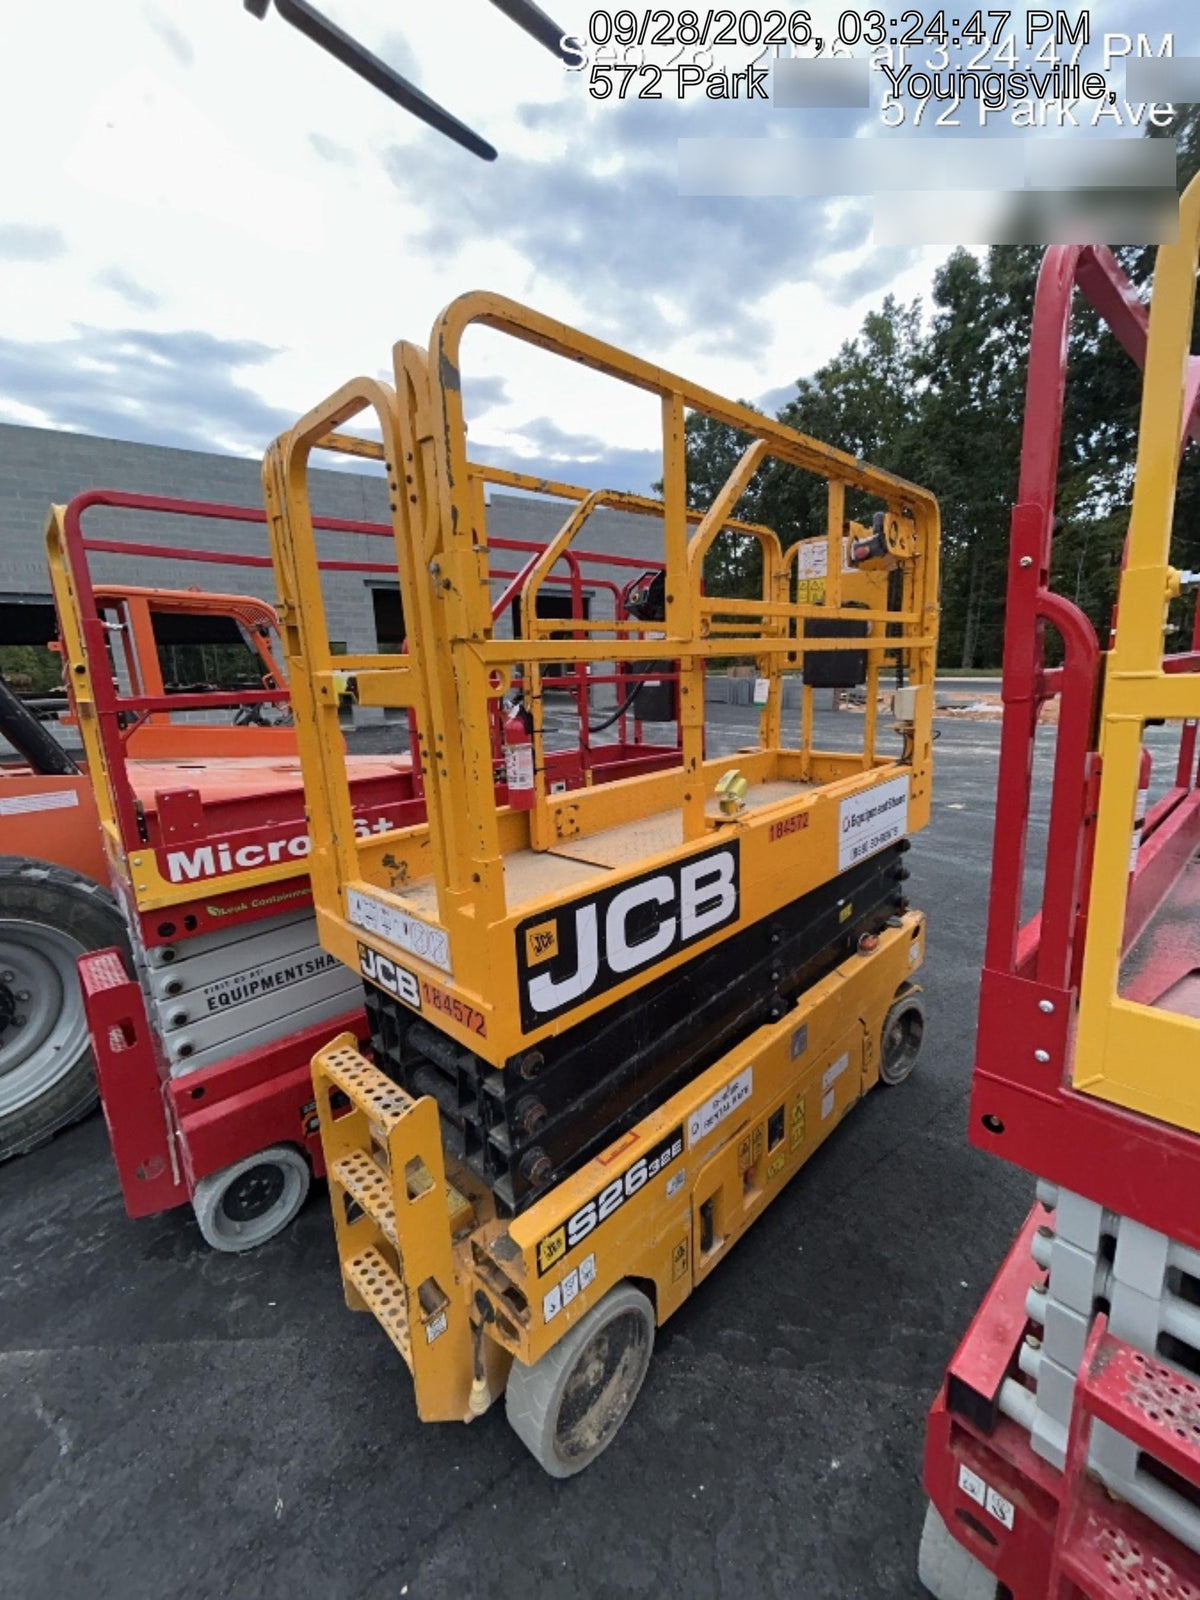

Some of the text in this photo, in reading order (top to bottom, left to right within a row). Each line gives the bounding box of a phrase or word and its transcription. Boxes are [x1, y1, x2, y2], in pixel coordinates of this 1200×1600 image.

[768, 812, 809, 842] 184572
[167, 835, 312, 882] Micro
[526, 844, 737, 1013] JCB
[207, 953, 343, 1010] EQUIPMENTSHA
[360, 949, 420, 1009] JCB
[422, 982, 488, 1040] 184572
